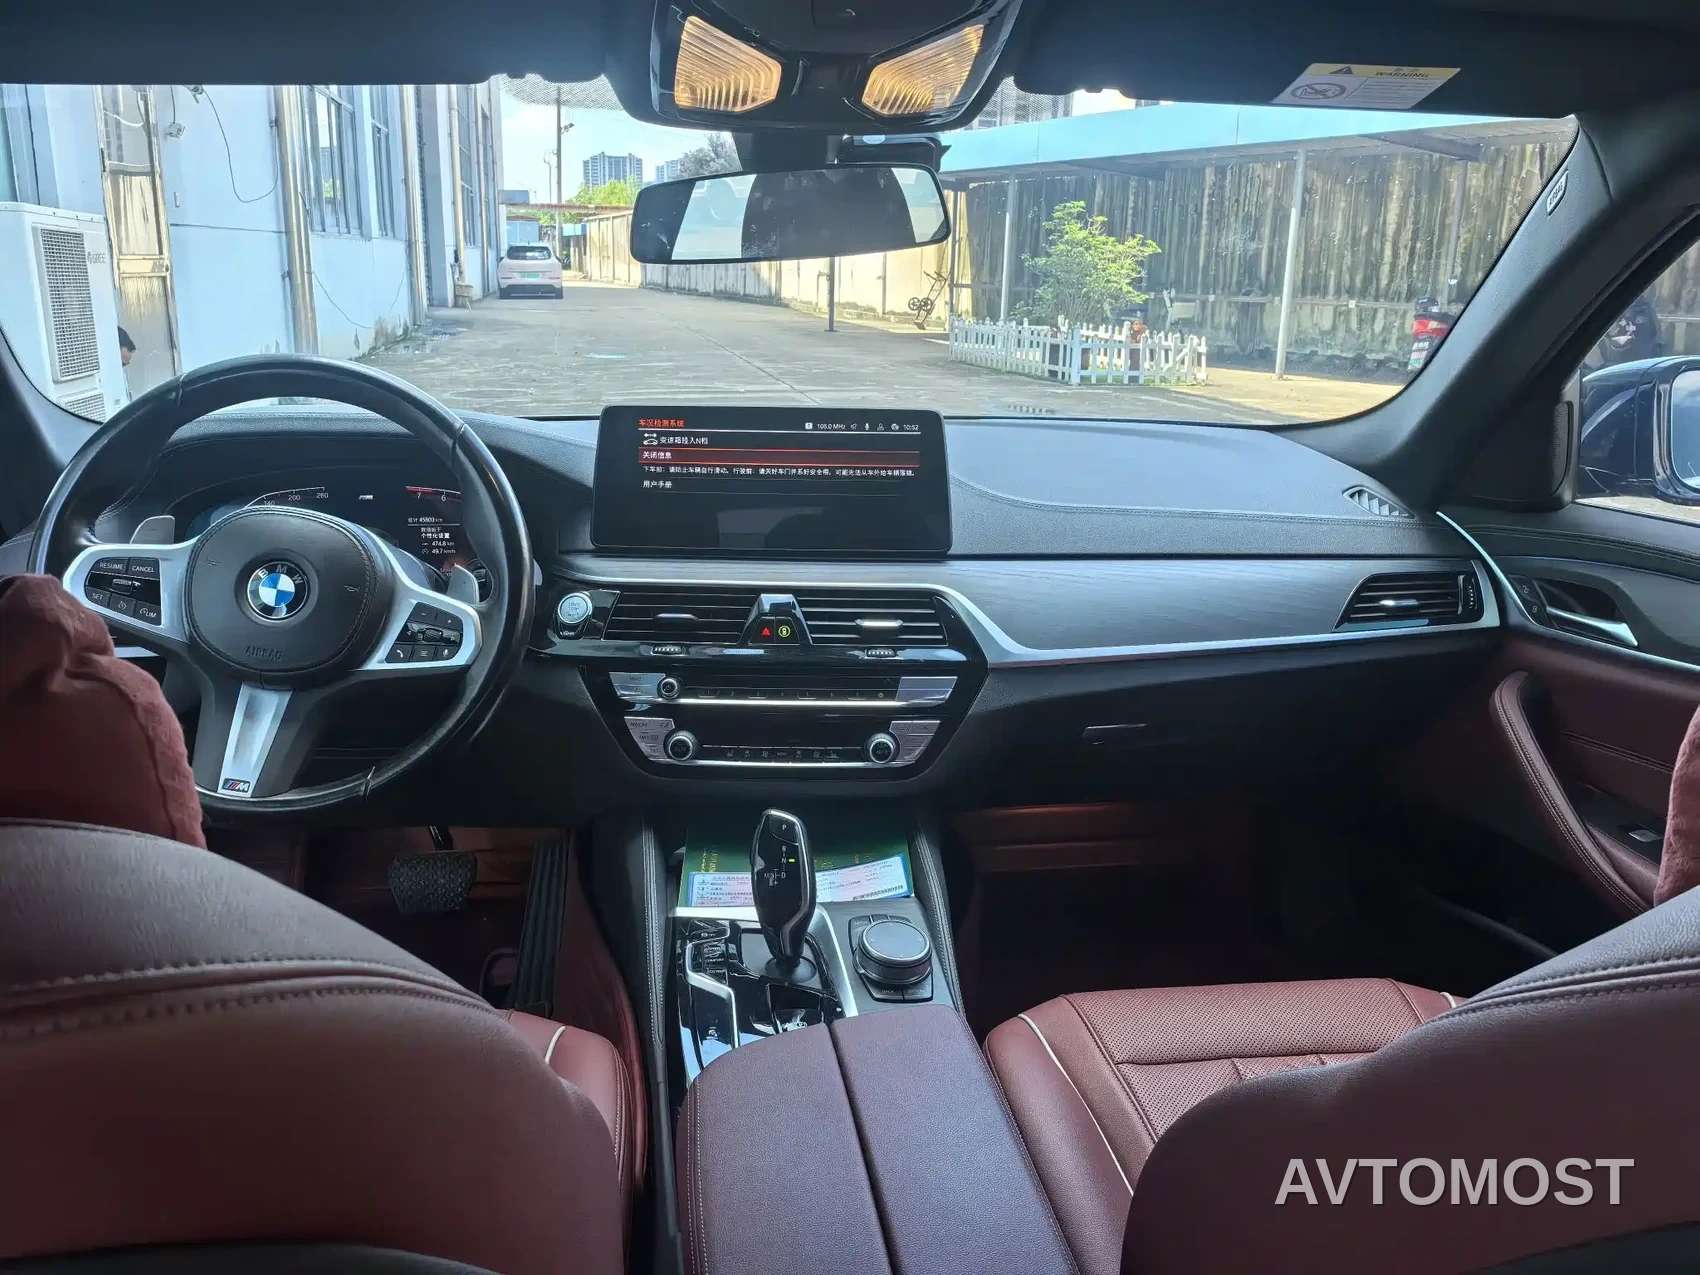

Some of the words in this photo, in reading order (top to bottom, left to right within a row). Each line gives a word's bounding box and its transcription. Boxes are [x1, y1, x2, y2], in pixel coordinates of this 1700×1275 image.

[639, 419, 685, 428] 车况检测系统
[642, 451, 673, 460] 关闭信息
[642, 480, 673, 489] 用户手册
[441, 494, 446, 502] 6
[100, 562, 124, 571] RESUME
[131, 565, 155, 573] CANCEL
[258, 564, 304, 585] BMW
[91, 592, 104, 600] SET
[245, 645, 283, 661] AIRBAG
